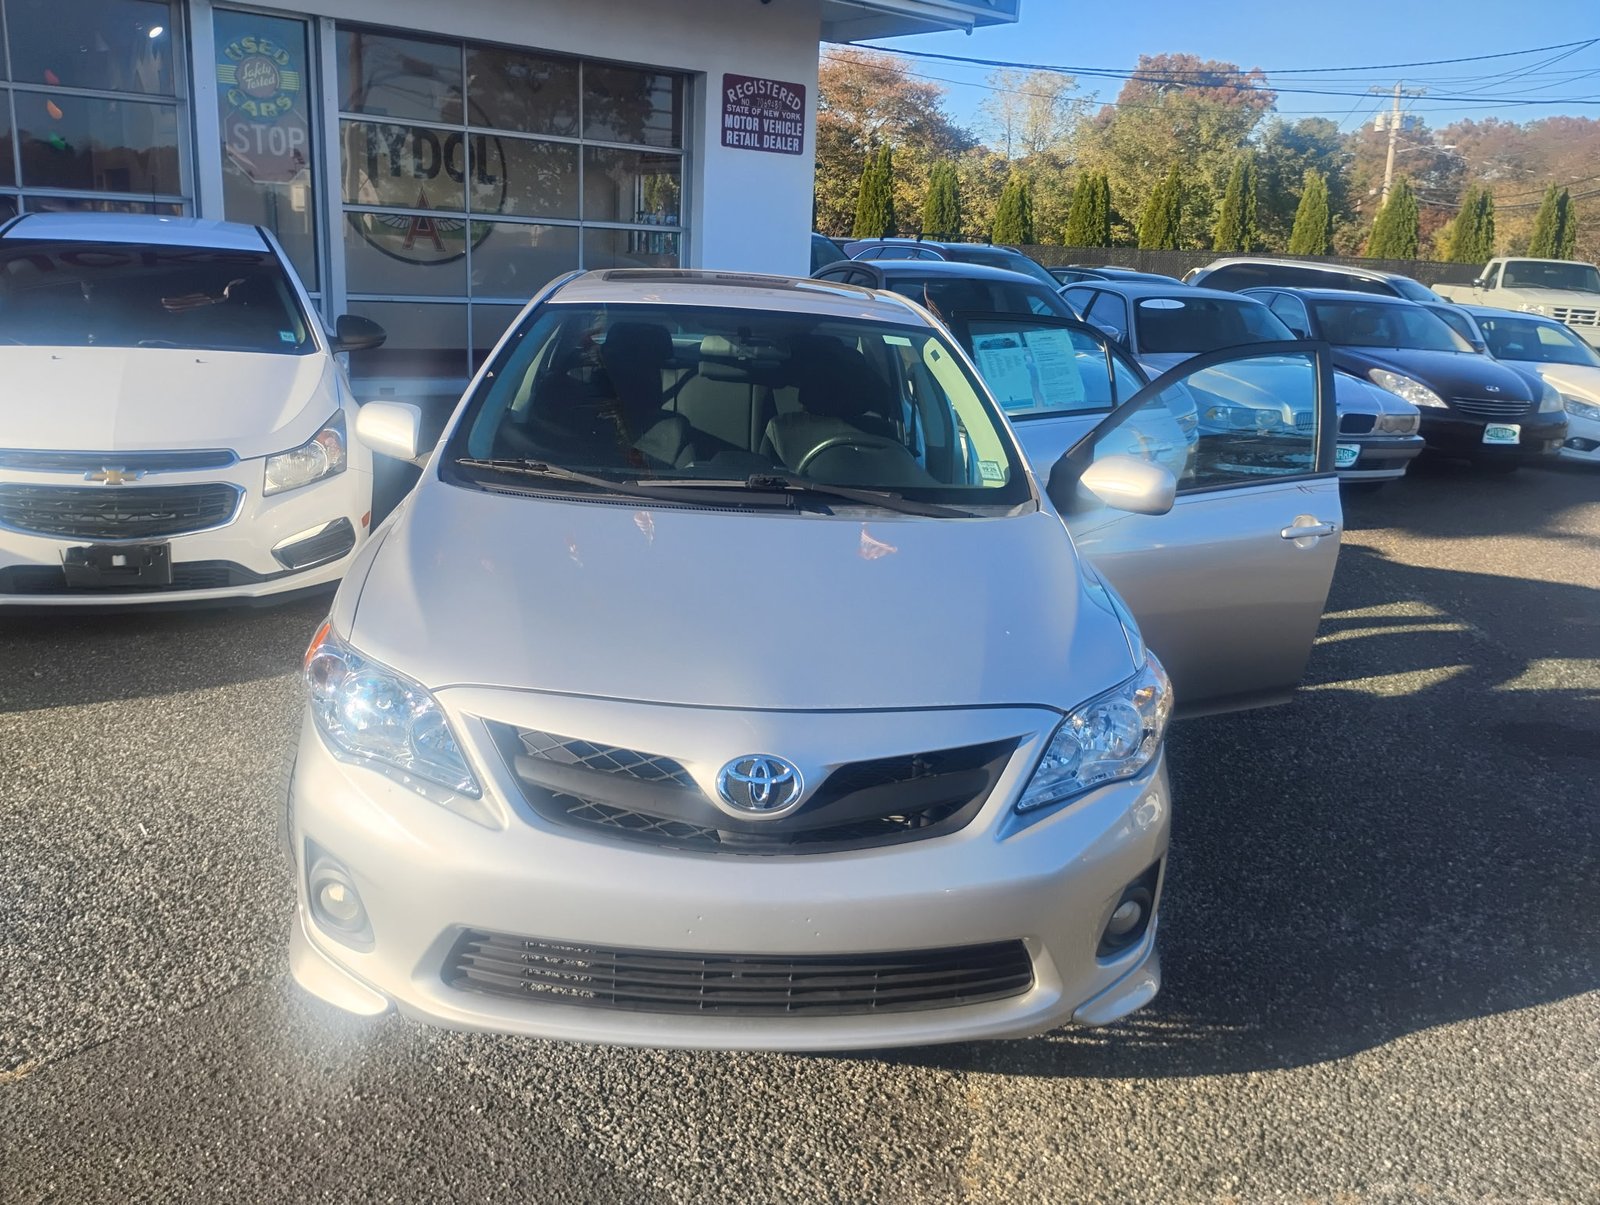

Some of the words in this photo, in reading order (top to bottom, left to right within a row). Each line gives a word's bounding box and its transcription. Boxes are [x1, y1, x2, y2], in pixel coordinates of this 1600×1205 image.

[224, 37, 290, 65] USED
[243, 62, 272, 79] Safety
[245, 74, 276, 89] Tested
[227, 89, 292, 117] CARS
[727, 80, 801, 110] REGISTERED
[726, 104, 749, 114] STATE
[751, 107, 761, 115] OF
[763, 110, 779, 118] NEW
[781, 111, 801, 120] YORK
[724, 114, 759, 132] MOTOR
[763, 118, 802, 136] VEHICLE
[233, 123, 305, 157] STOP
[726, 130, 760, 147] RETAIL
[763, 134, 800, 151] DEALER
